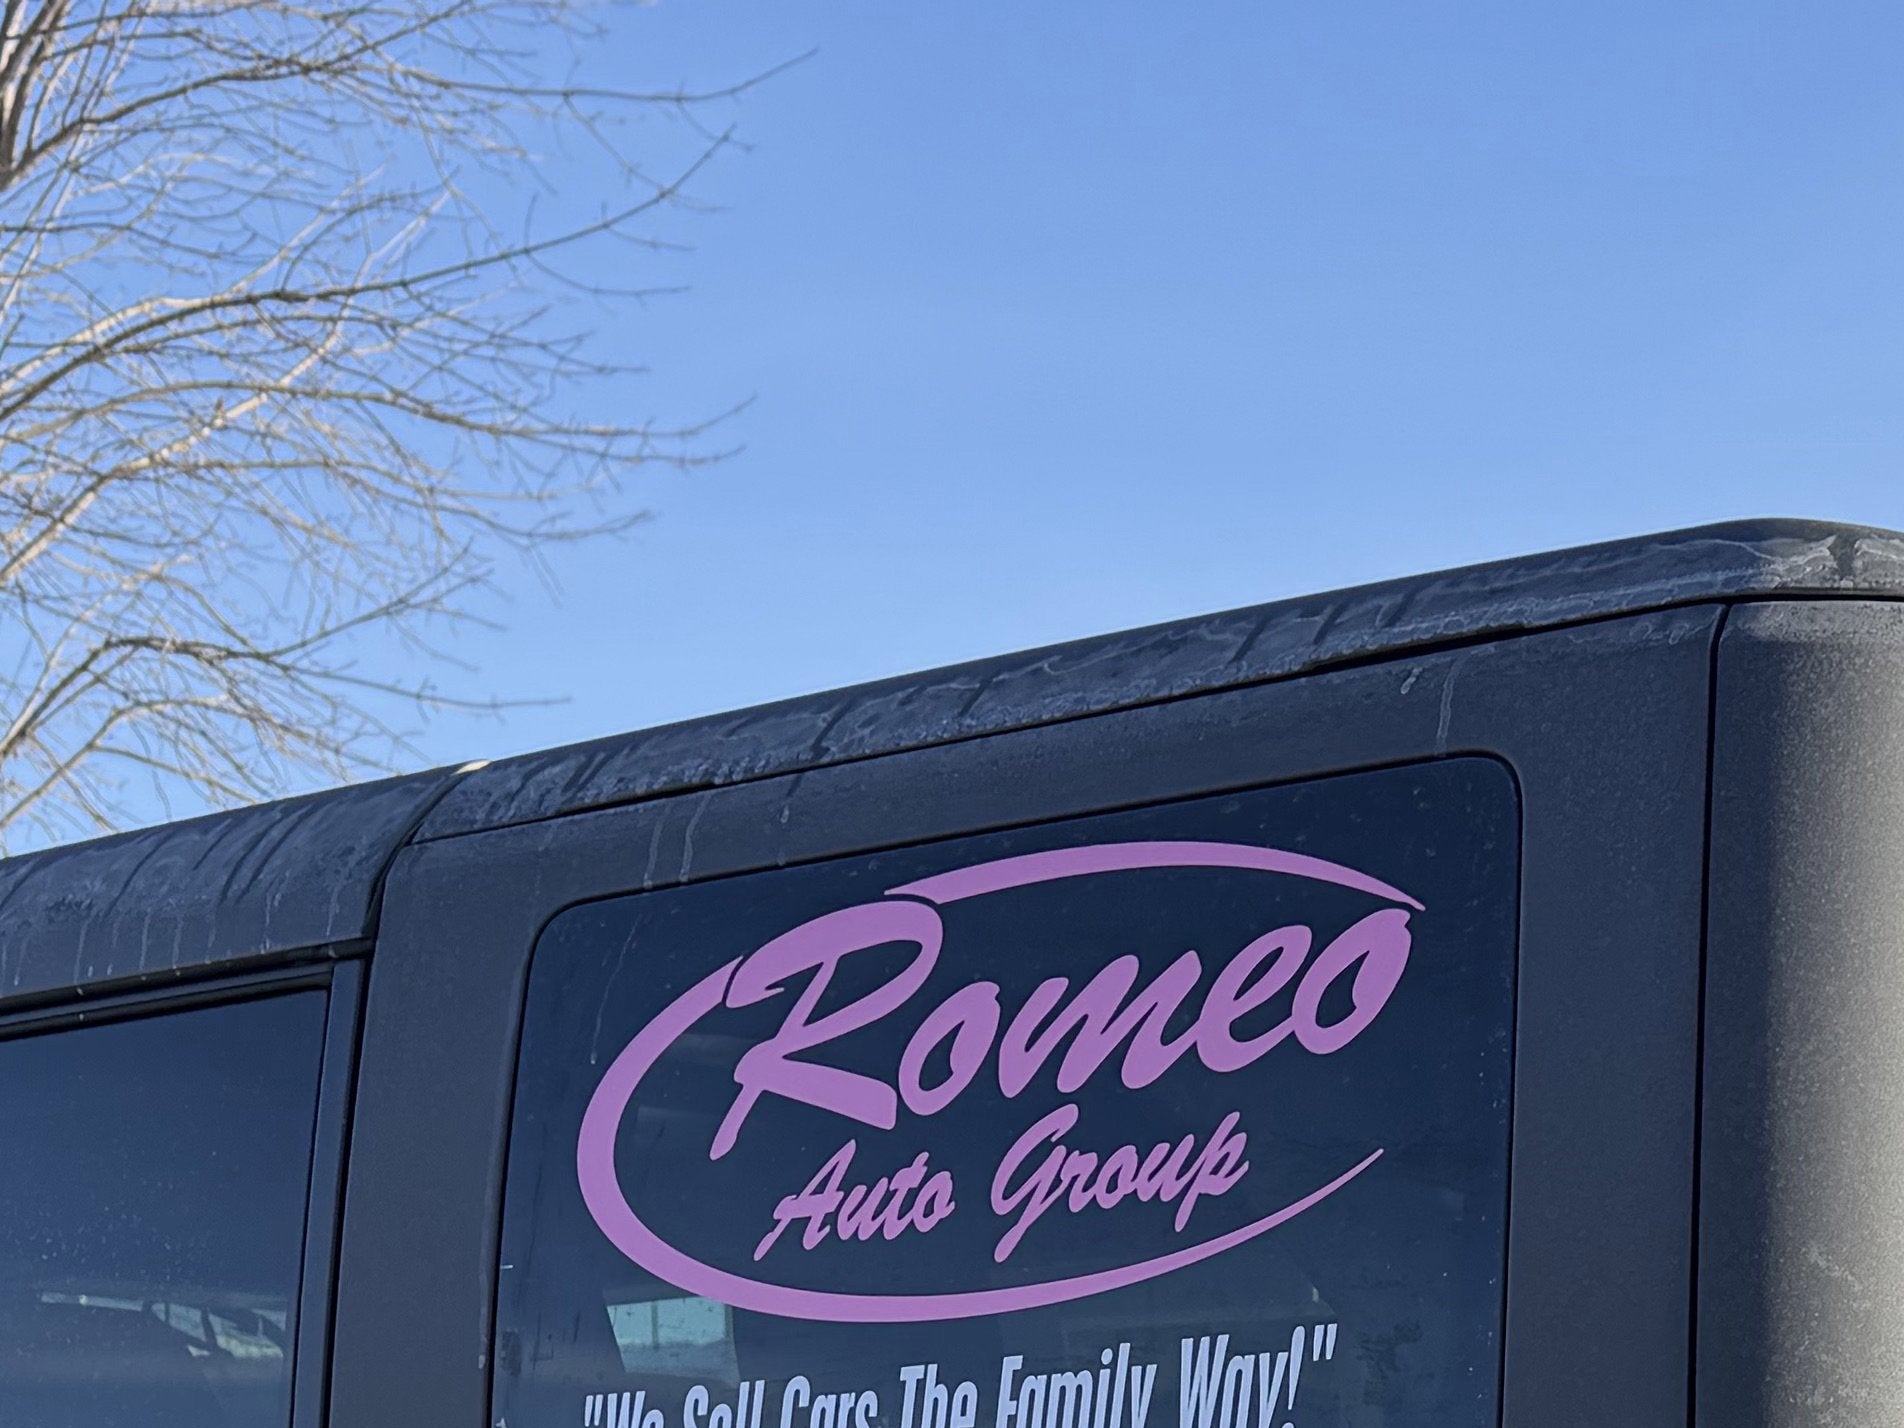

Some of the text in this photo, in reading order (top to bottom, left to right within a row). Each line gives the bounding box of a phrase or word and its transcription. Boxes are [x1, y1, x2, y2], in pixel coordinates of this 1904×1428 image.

[711, 903, 1412, 1158] Romeo
[753, 1104, 1250, 1264] Auto Group
